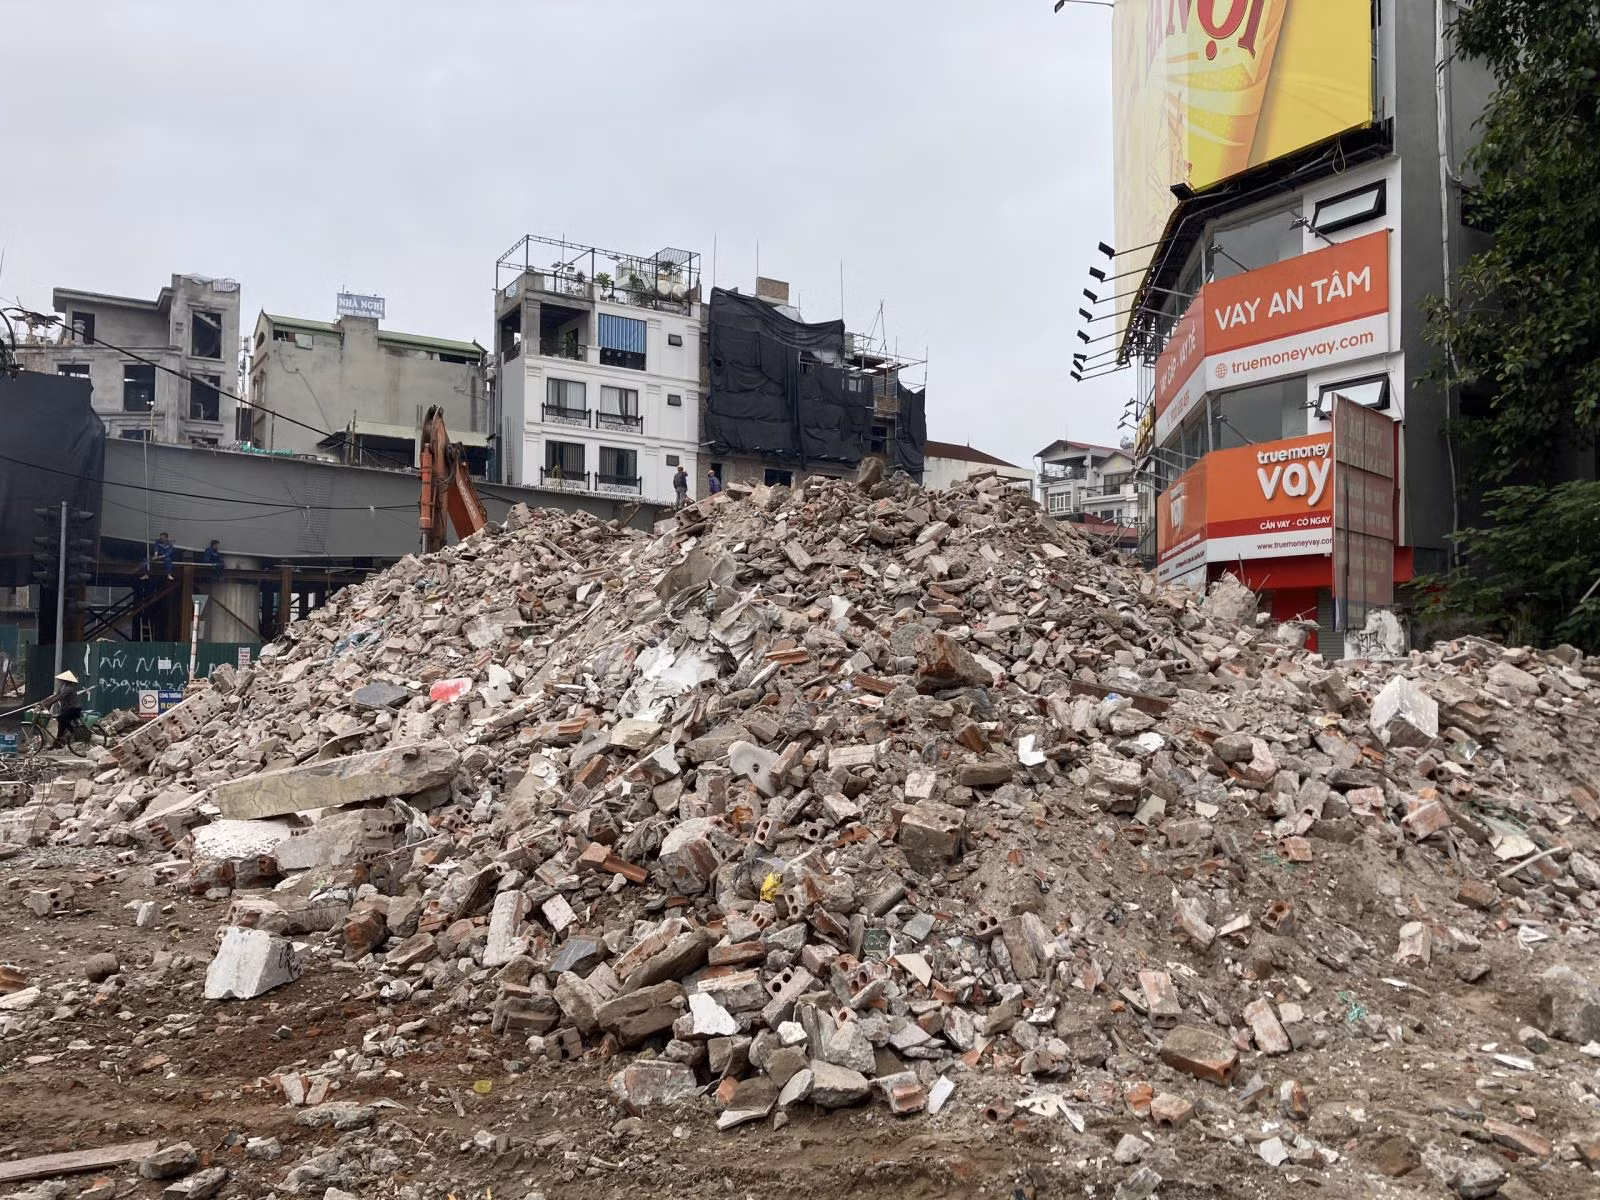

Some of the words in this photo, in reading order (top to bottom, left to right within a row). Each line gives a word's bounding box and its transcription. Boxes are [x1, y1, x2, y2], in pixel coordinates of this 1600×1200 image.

[339, 297, 359, 308] NHÀ
[1215, 297, 1260, 331] VAY
[1268, 285, 1303, 318] AN
[1311, 265, 1371, 305] TÂM
[1232, 331, 1374, 374] truemoneyvay.com
[1257, 442, 1331, 465] truemoney
[1257, 458, 1332, 507] vay
[1276, 519, 1291, 529] VAY
[1310, 515, 1331, 525] NGAY
